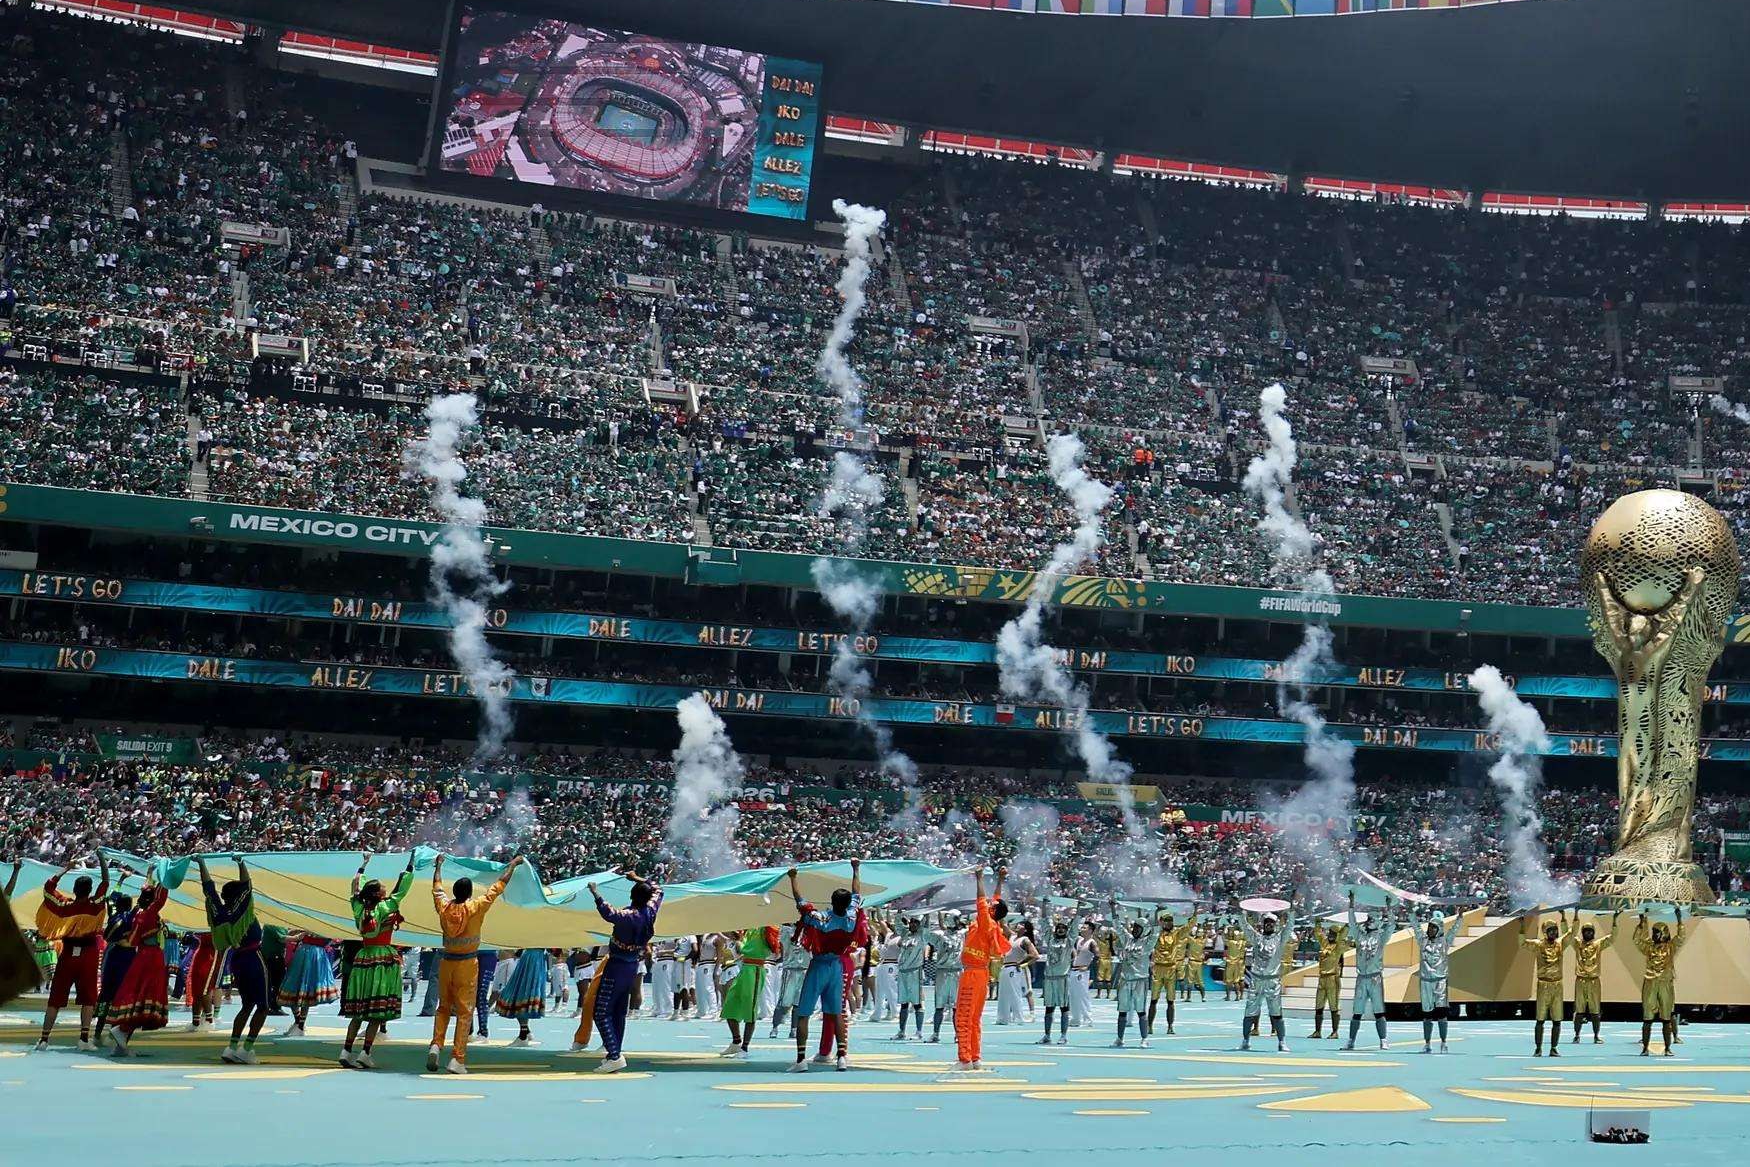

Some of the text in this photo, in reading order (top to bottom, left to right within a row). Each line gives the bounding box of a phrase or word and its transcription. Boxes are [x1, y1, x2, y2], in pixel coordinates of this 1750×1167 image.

[230, 513, 439, 545] MEXICO CITY
[22, 573, 122, 599] LET'S GO
[332, 597, 401, 621] DAI DAI
[1259, 596, 1342, 616] #FIFAWorldCup
[589, 618, 631, 638] DALE
[699, 625, 753, 647] ALLEZ
[854, 635, 878, 654] GO
[57, 647, 97, 671] IKO
[188, 658, 235, 680] DALE
[1080, 651, 1107, 669] DAI
[1166, 655, 1195, 674] IKO
[311, 667, 373, 691] ALLEZ
[1358, 667, 1406, 687] ALLEZ
[736, 692, 764, 711] DAI
[1702, 684, 1728, 702] DAI
[934, 703, 974, 723] DALE
[1128, 715, 1203, 736] LET'S GO
[146, 741, 166, 752] EXIT
[1364, 727, 1418, 747] DAI DAI
[1570, 738, 1605, 755] DALE
